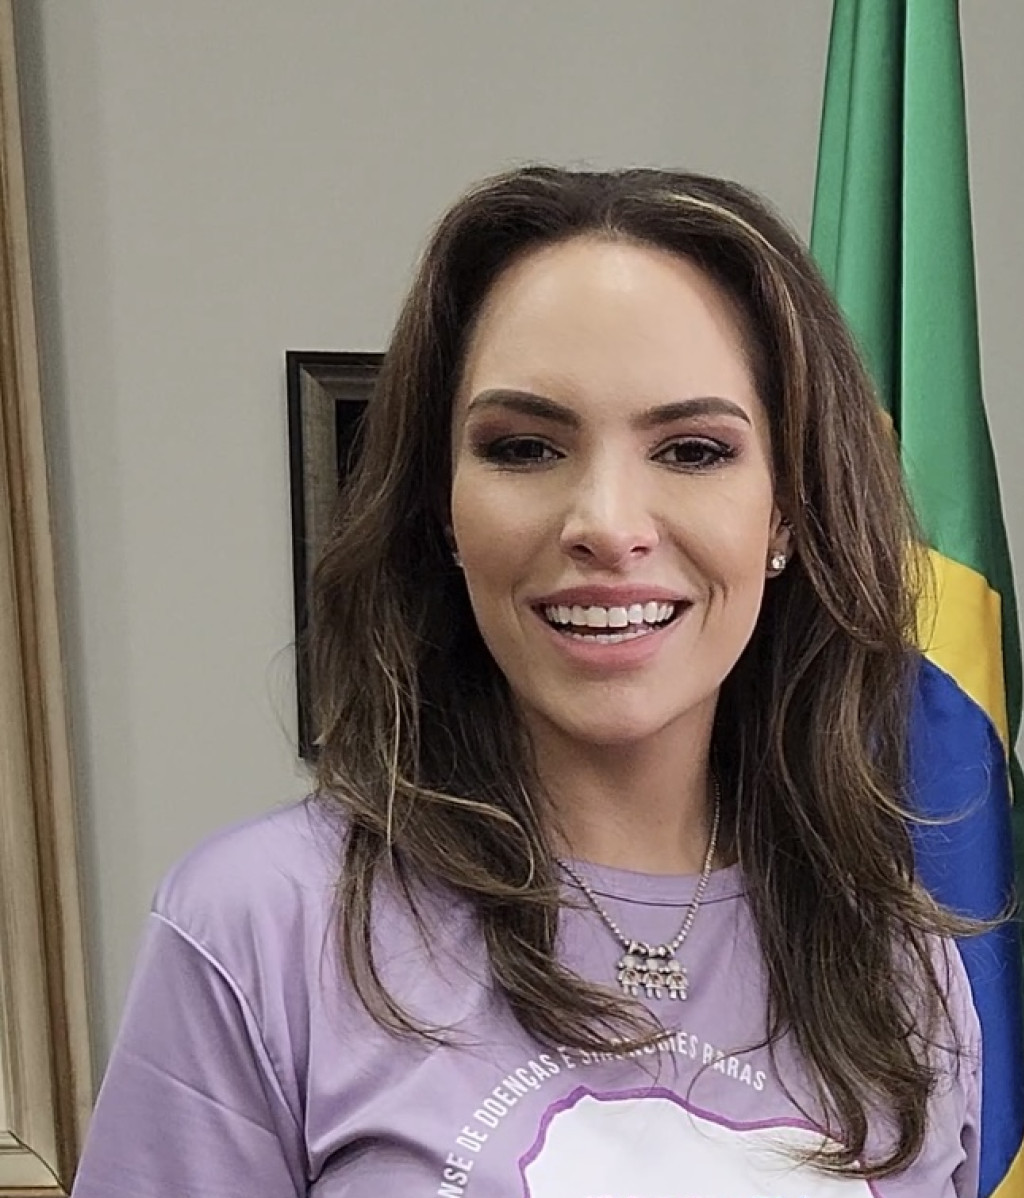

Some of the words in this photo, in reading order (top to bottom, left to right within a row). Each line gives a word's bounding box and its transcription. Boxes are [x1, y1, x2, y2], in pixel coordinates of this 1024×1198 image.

[457, 1126, 488, 1153] DE
[473, 1053, 561, 1128] DOENÇAS
[702, 1043, 766, 1090] RARAS
